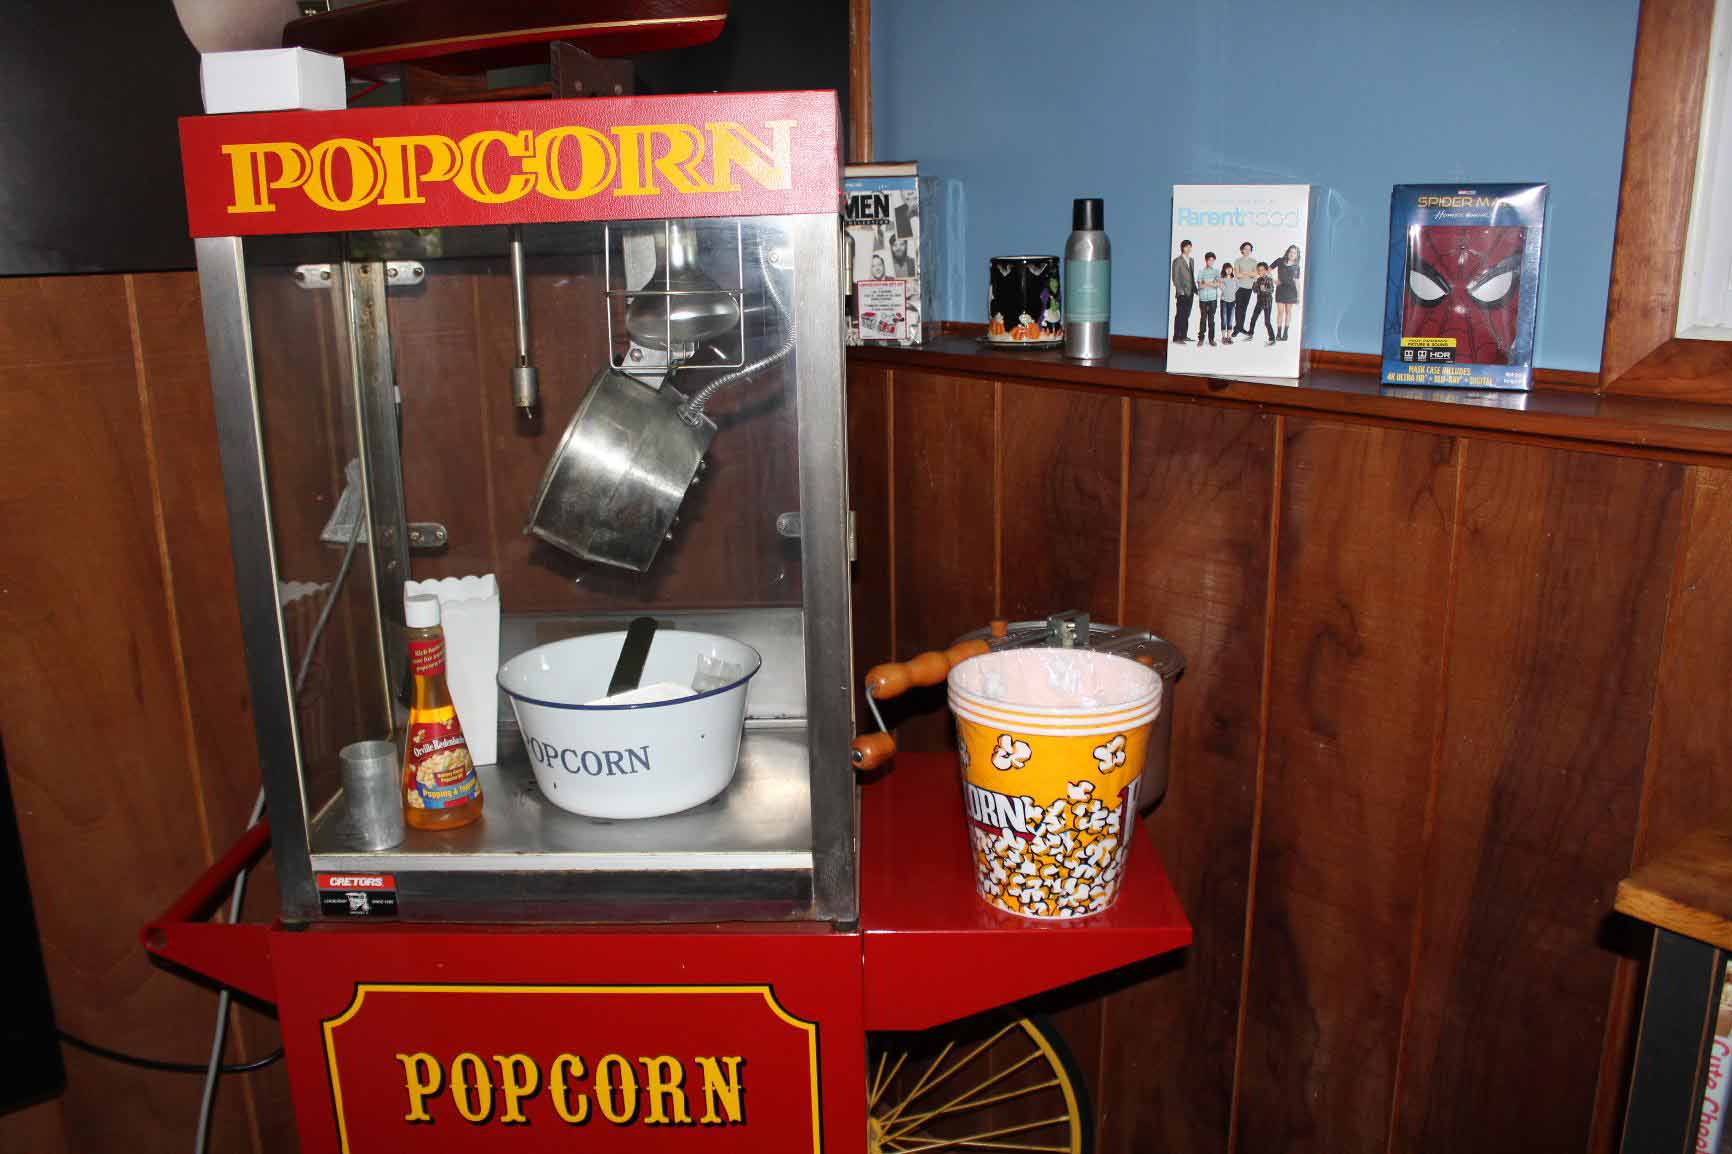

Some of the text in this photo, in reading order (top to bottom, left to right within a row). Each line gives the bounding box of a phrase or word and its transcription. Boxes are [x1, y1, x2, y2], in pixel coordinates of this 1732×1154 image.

[221, 119, 798, 214] POPCORN
[526, 736, 651, 776] OPCORN
[329, 877, 384, 887] CRETORS
[396, 1053, 745, 1126] POPCORN
